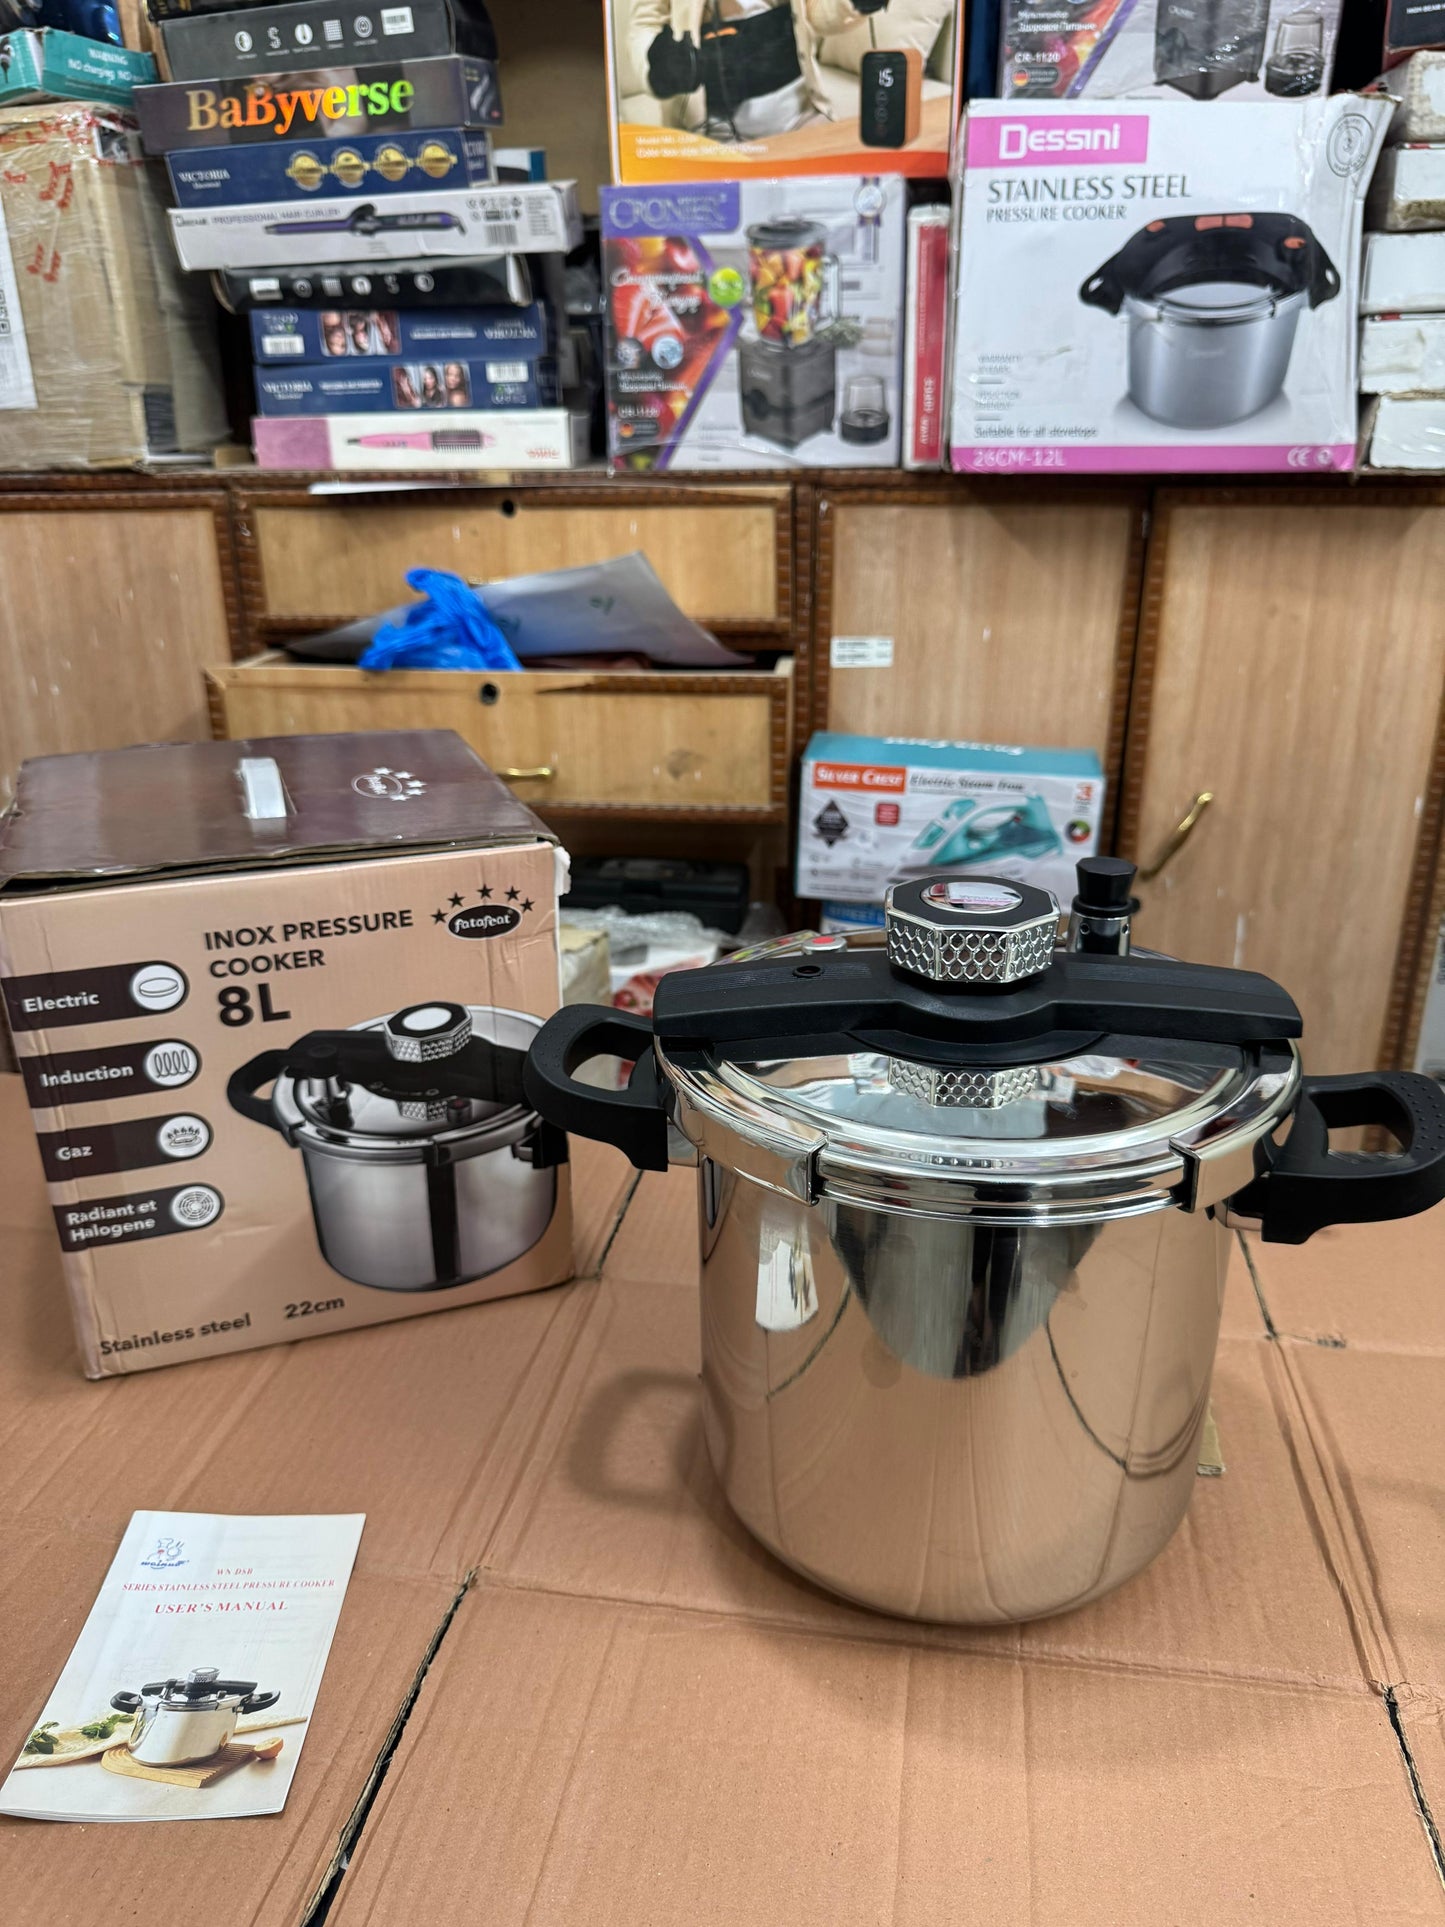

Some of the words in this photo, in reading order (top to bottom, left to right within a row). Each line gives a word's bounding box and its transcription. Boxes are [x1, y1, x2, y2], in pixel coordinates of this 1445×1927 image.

[987, 176, 1115, 204] STAINLESS
[1122, 174, 1192, 200] STEEL
[986, 207, 1057, 223] PRESSURE
[1062, 204, 1128, 221] COOKER
[973, 447, 1066, 467] 26CM-12L
[204, 925, 278, 950] INOX
[283, 909, 414, 942] PRESSURE
[454, 911, 512, 934] fatafeat
[208, 949, 327, 979] COOKER
[24, 992, 100, 1013] Electric
[217, 982, 292, 1028] 8L
[40, 1063, 134, 1087] Induction
[56, 1146, 93, 1160] Gaz
[66, 1204, 135, 1226] Radiant
[137, 1200, 158, 1214] et
[70, 1217, 157, 1243] Halogene
[284, 1297, 345, 1321] 22cm
[101, 1326, 195, 1355] Stainless
[199, 1313, 251, 1336] steel
[122, 1583, 157, 1591] SERIES
[158, 1583, 210, 1591] STAINLESS
[211, 1582, 241, 1590] STEEL
[242, 1581, 292, 1590] PRESSURE
[293, 1579, 336, 1588] COOKER
[155, 1603, 213, 1614] USER'S
[216, 1600, 288, 1612] MANUAL
